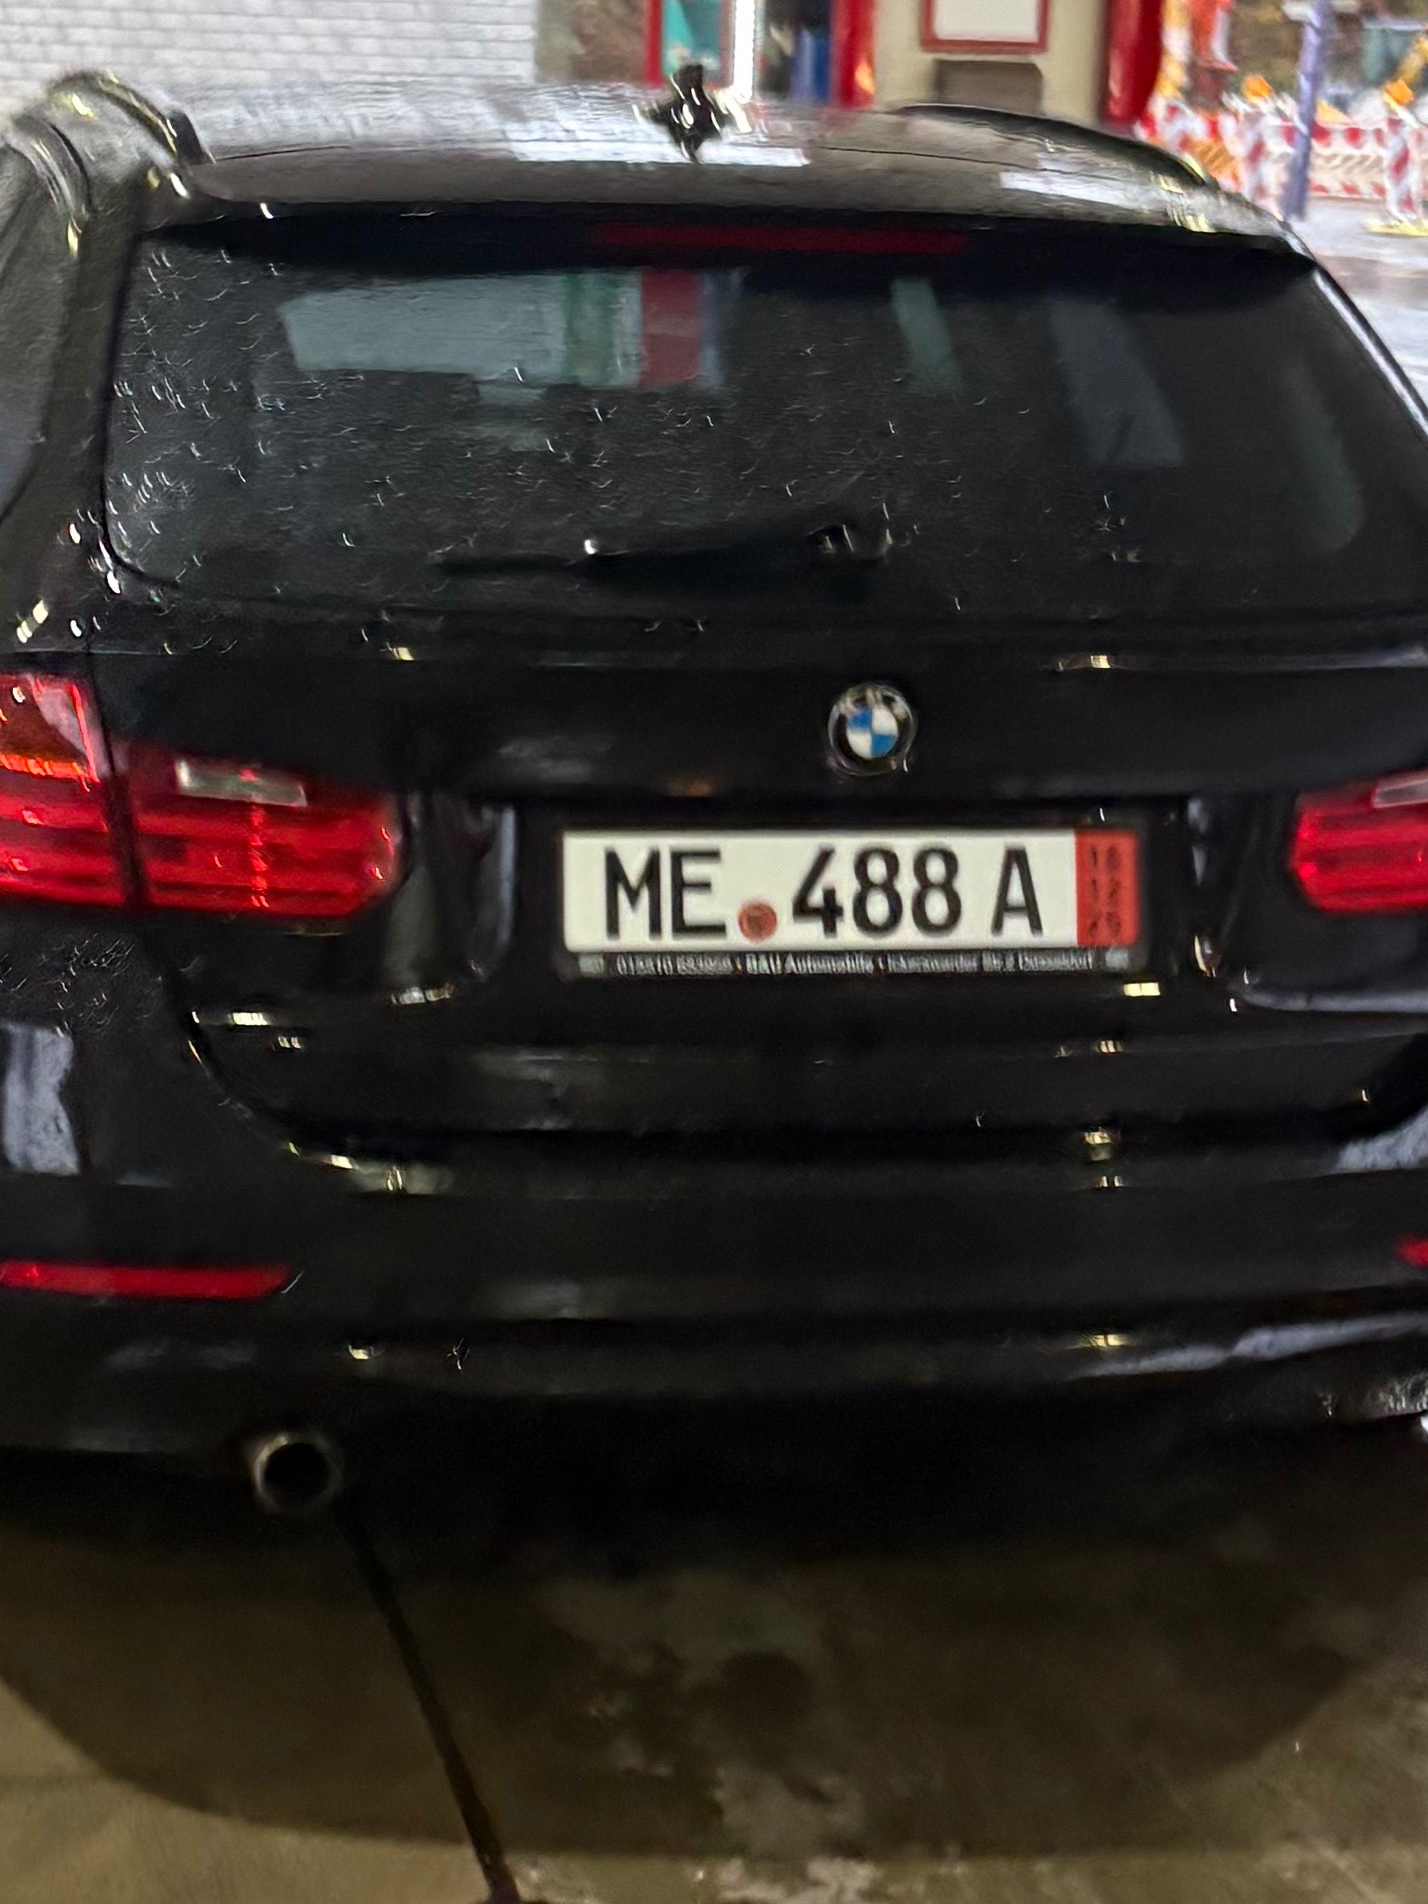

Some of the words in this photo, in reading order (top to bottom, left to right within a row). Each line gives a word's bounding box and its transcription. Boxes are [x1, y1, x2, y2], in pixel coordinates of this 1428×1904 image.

[603, 846, 727, 940] ME
[791, 844, 963, 939] 488
[990, 844, 1044, 938] A
